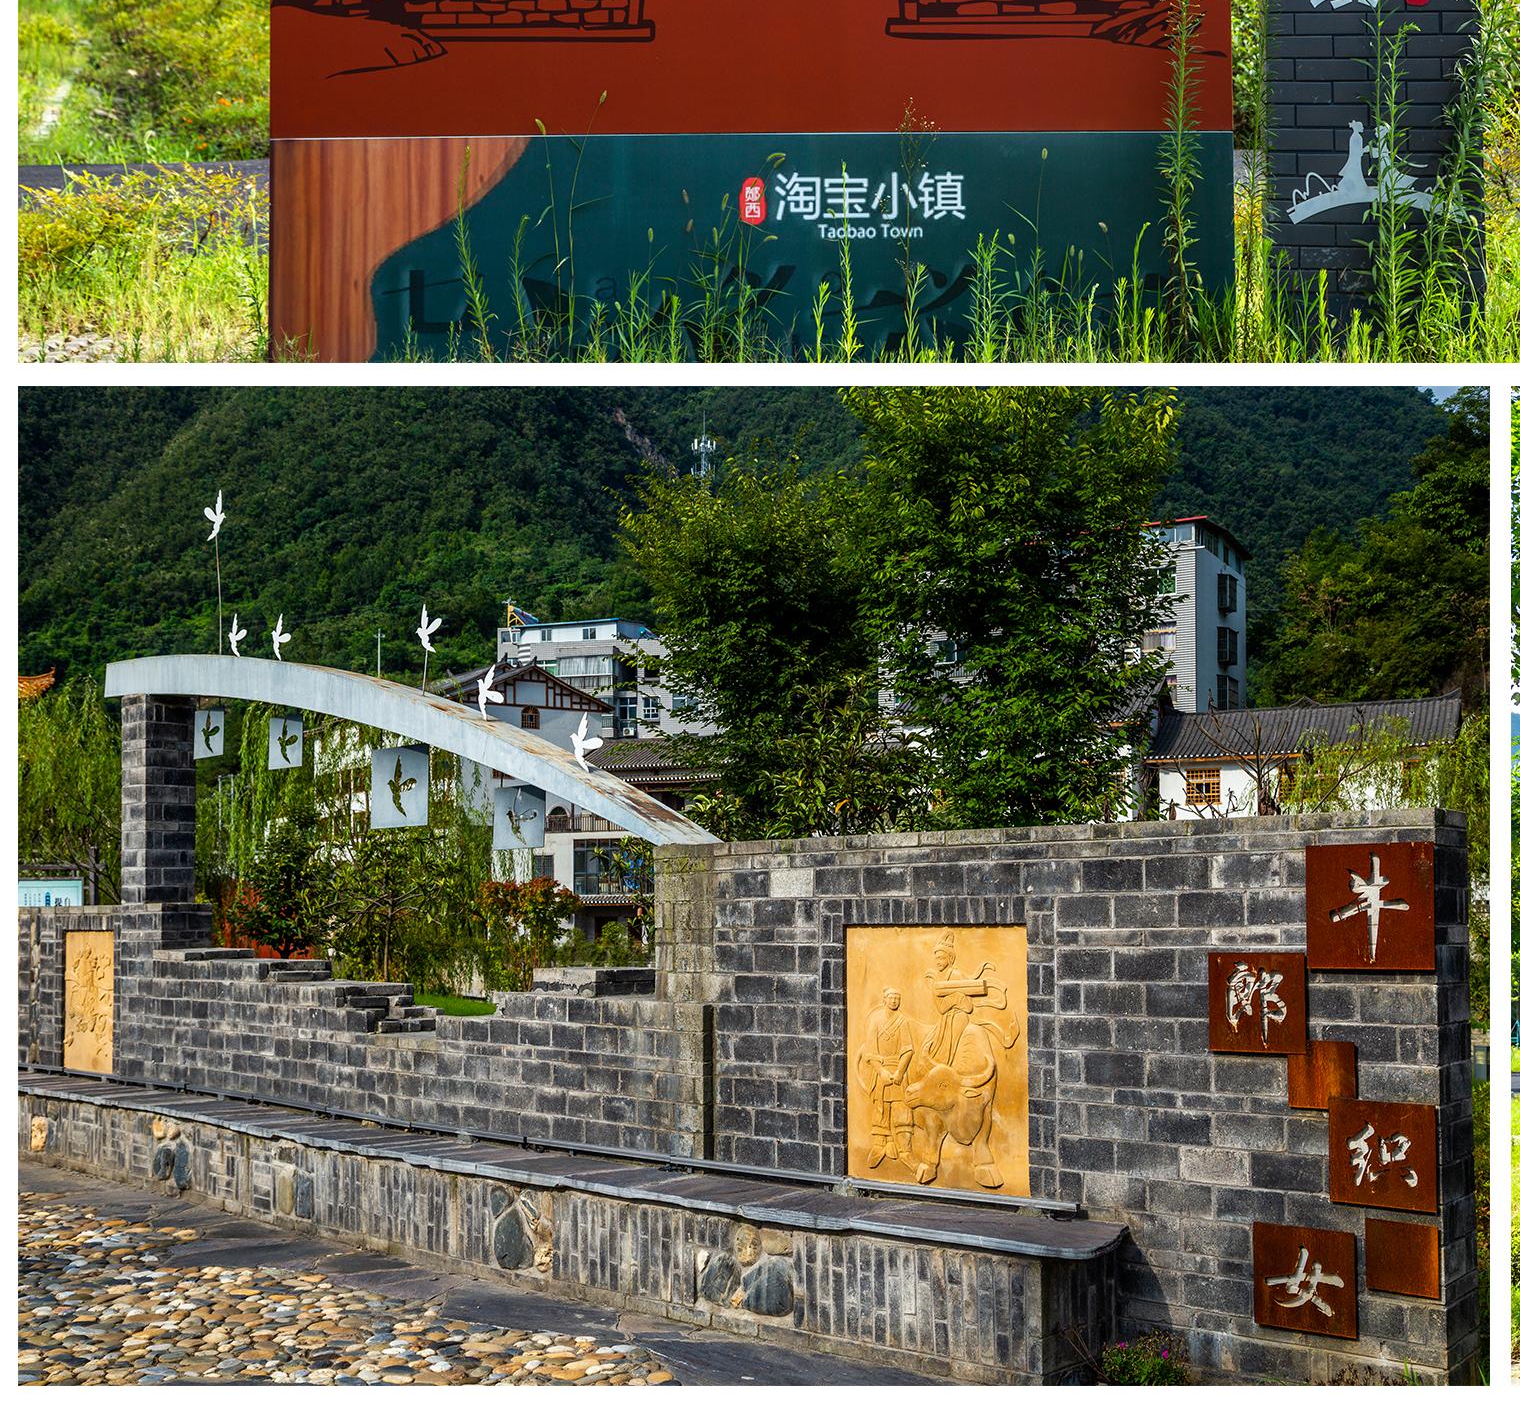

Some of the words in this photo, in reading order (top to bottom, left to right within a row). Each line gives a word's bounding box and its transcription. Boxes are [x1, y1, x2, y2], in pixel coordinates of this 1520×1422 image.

[775, 172, 966, 221] 淘宝小镇
[818, 224, 876, 239] Taobao
[882, 224, 924, 238] Town
